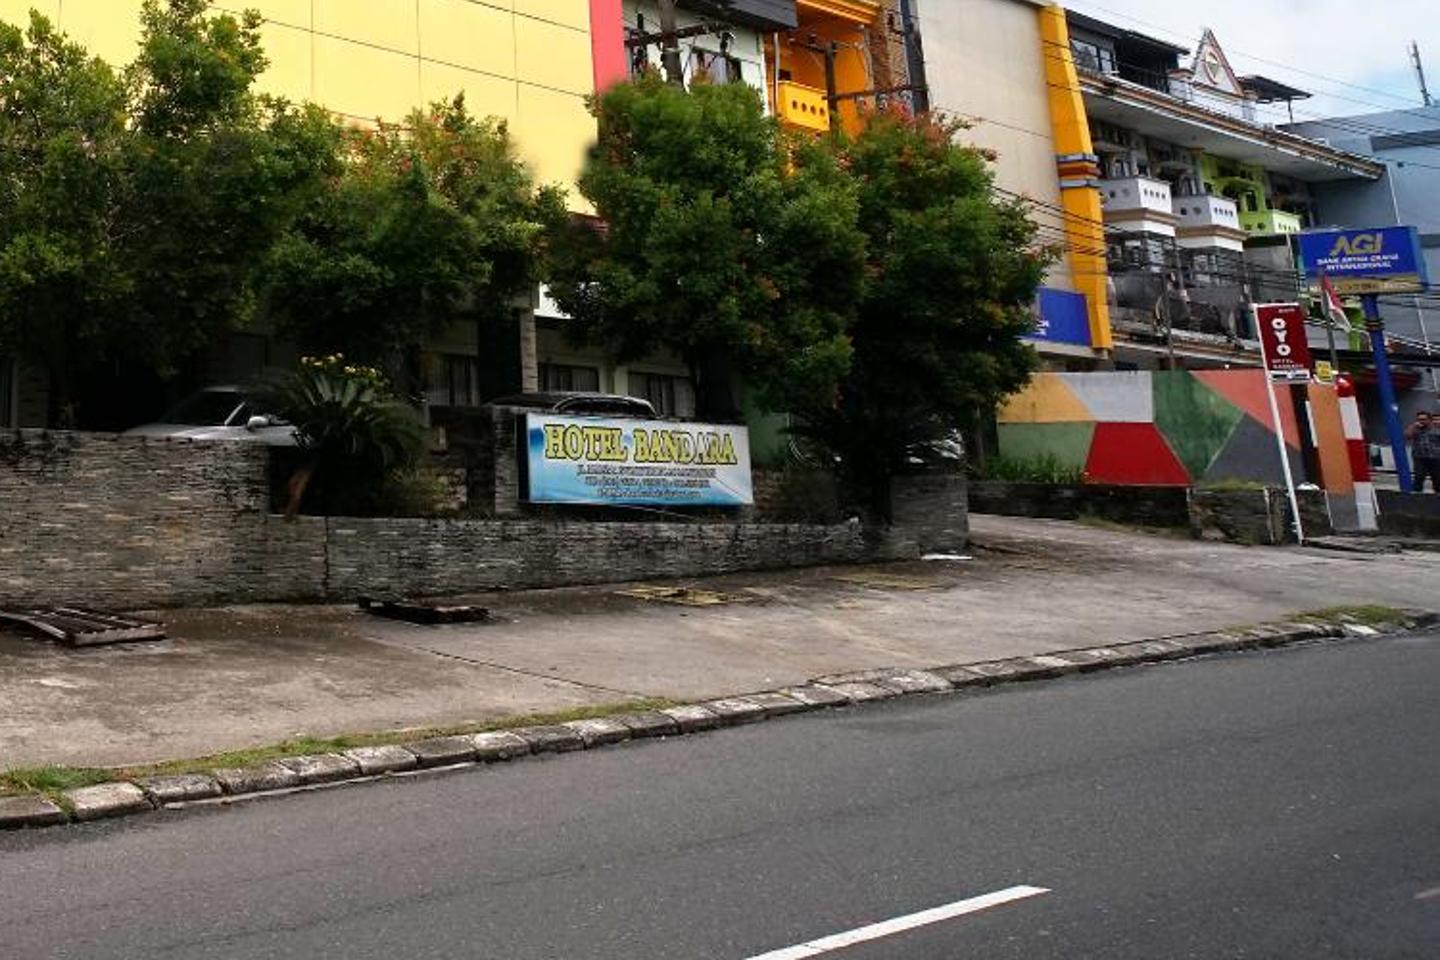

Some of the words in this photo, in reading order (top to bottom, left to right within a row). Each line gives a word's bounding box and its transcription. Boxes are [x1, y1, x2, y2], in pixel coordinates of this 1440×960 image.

[1329, 232, 1384, 256] AGI
[1271, 317, 1292, 357] OYO
[543, 424, 628, 463] HOTEL
[632, 428, 738, 465] BANDARA
